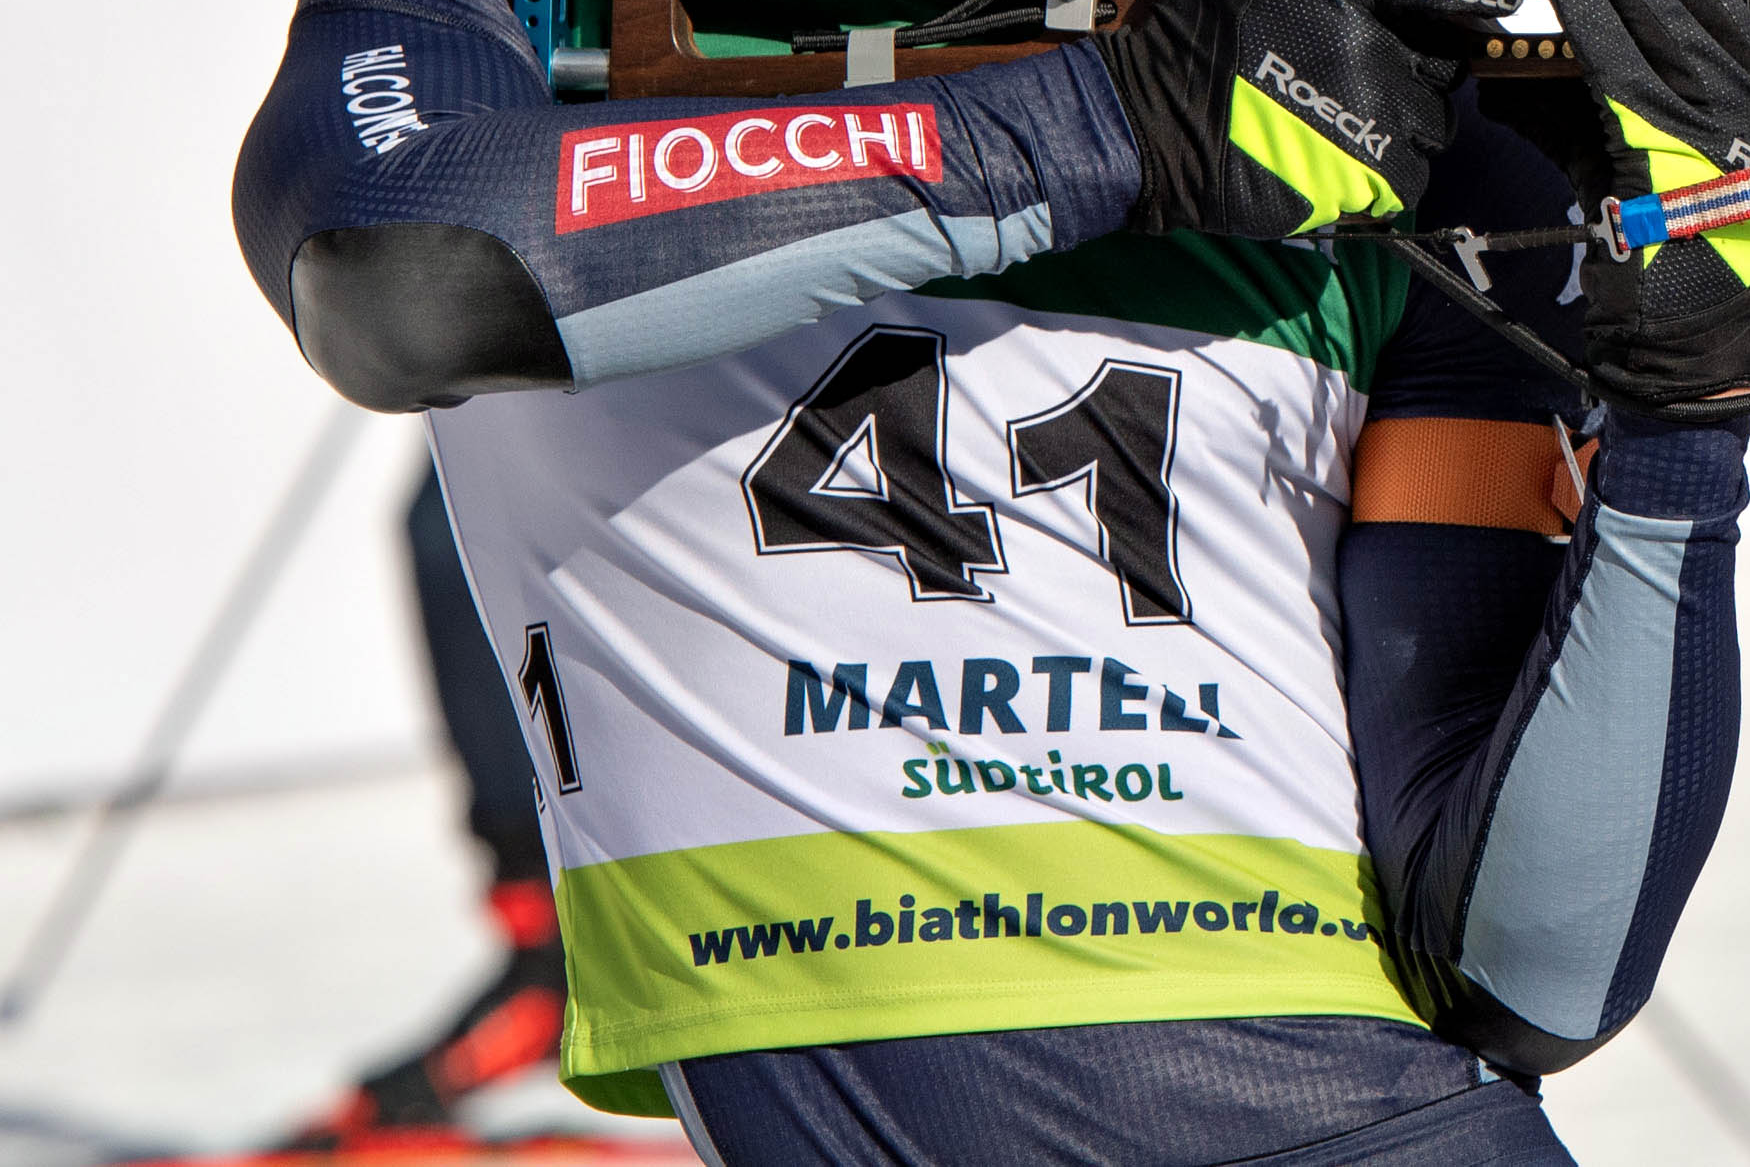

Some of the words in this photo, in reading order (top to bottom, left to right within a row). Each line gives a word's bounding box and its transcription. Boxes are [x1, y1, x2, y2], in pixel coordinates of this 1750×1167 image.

[571, 111, 928, 217] FIOCCHI
[739, 322, 1194, 627] 41
[518, 620, 584, 797] 1
